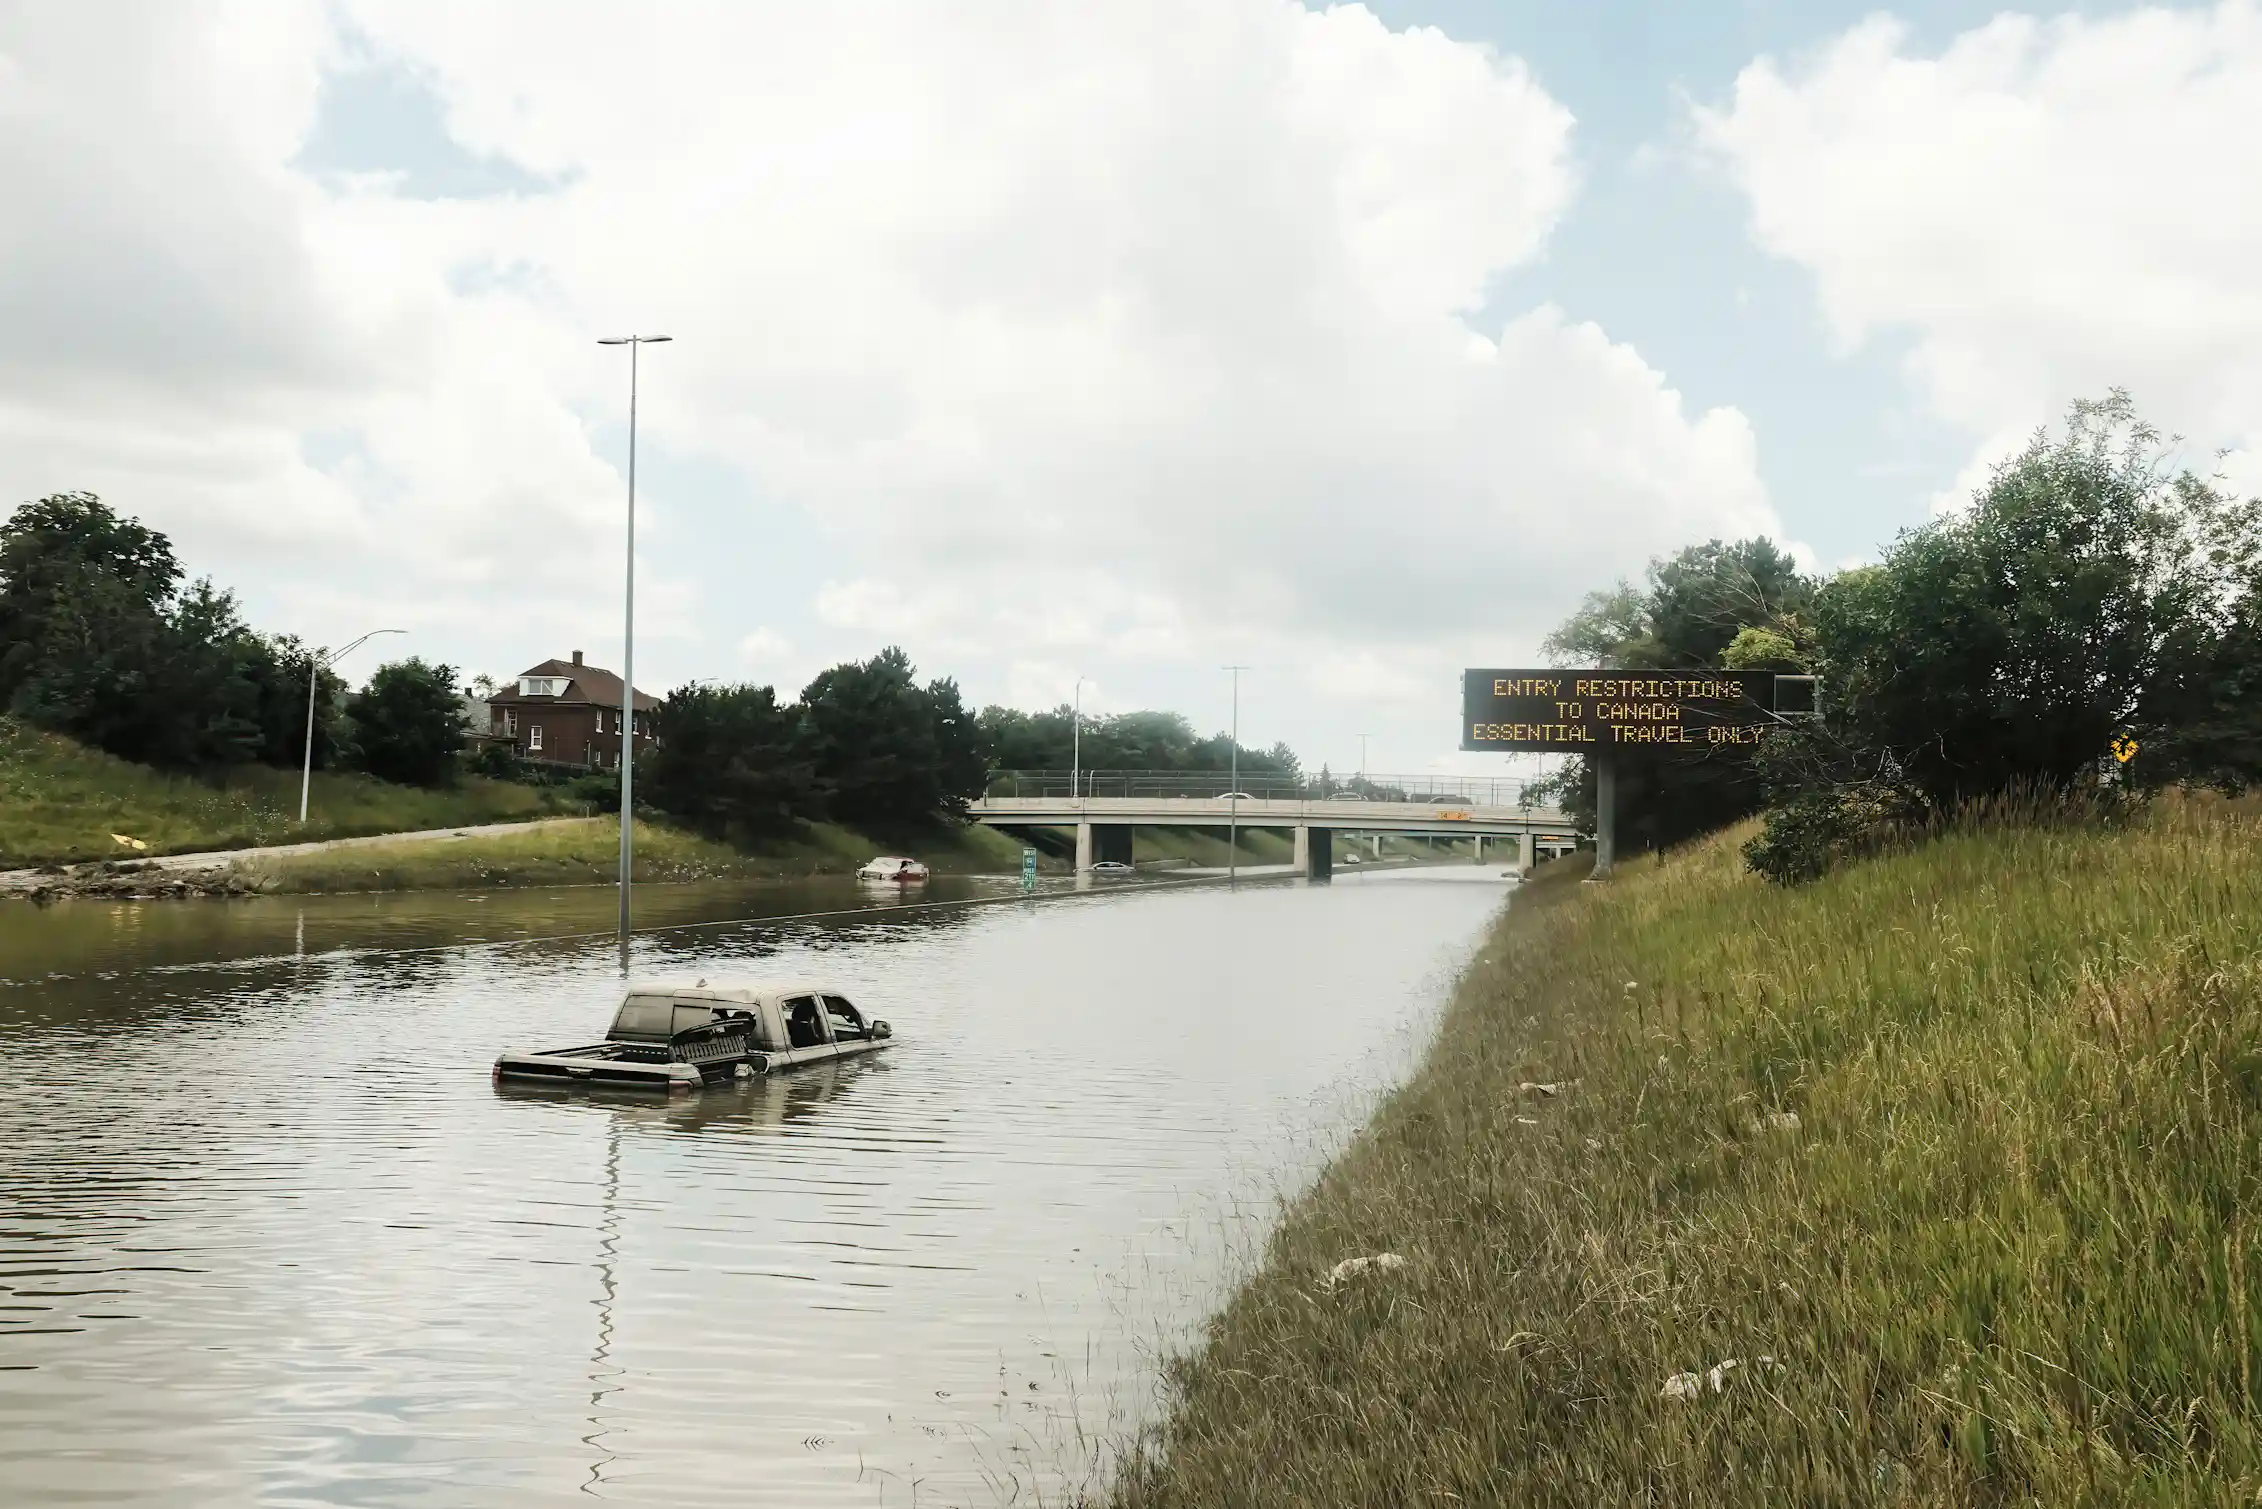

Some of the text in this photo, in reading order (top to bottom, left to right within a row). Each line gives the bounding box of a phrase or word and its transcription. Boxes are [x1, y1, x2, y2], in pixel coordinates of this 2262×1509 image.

[1494, 679, 1743, 697] ENTRY RESTRICTIONS
[1555, 702, 1679, 719] TO CANADA
[1473, 723, 1764, 743] ESSENTIAL TRAVEL ONLY
